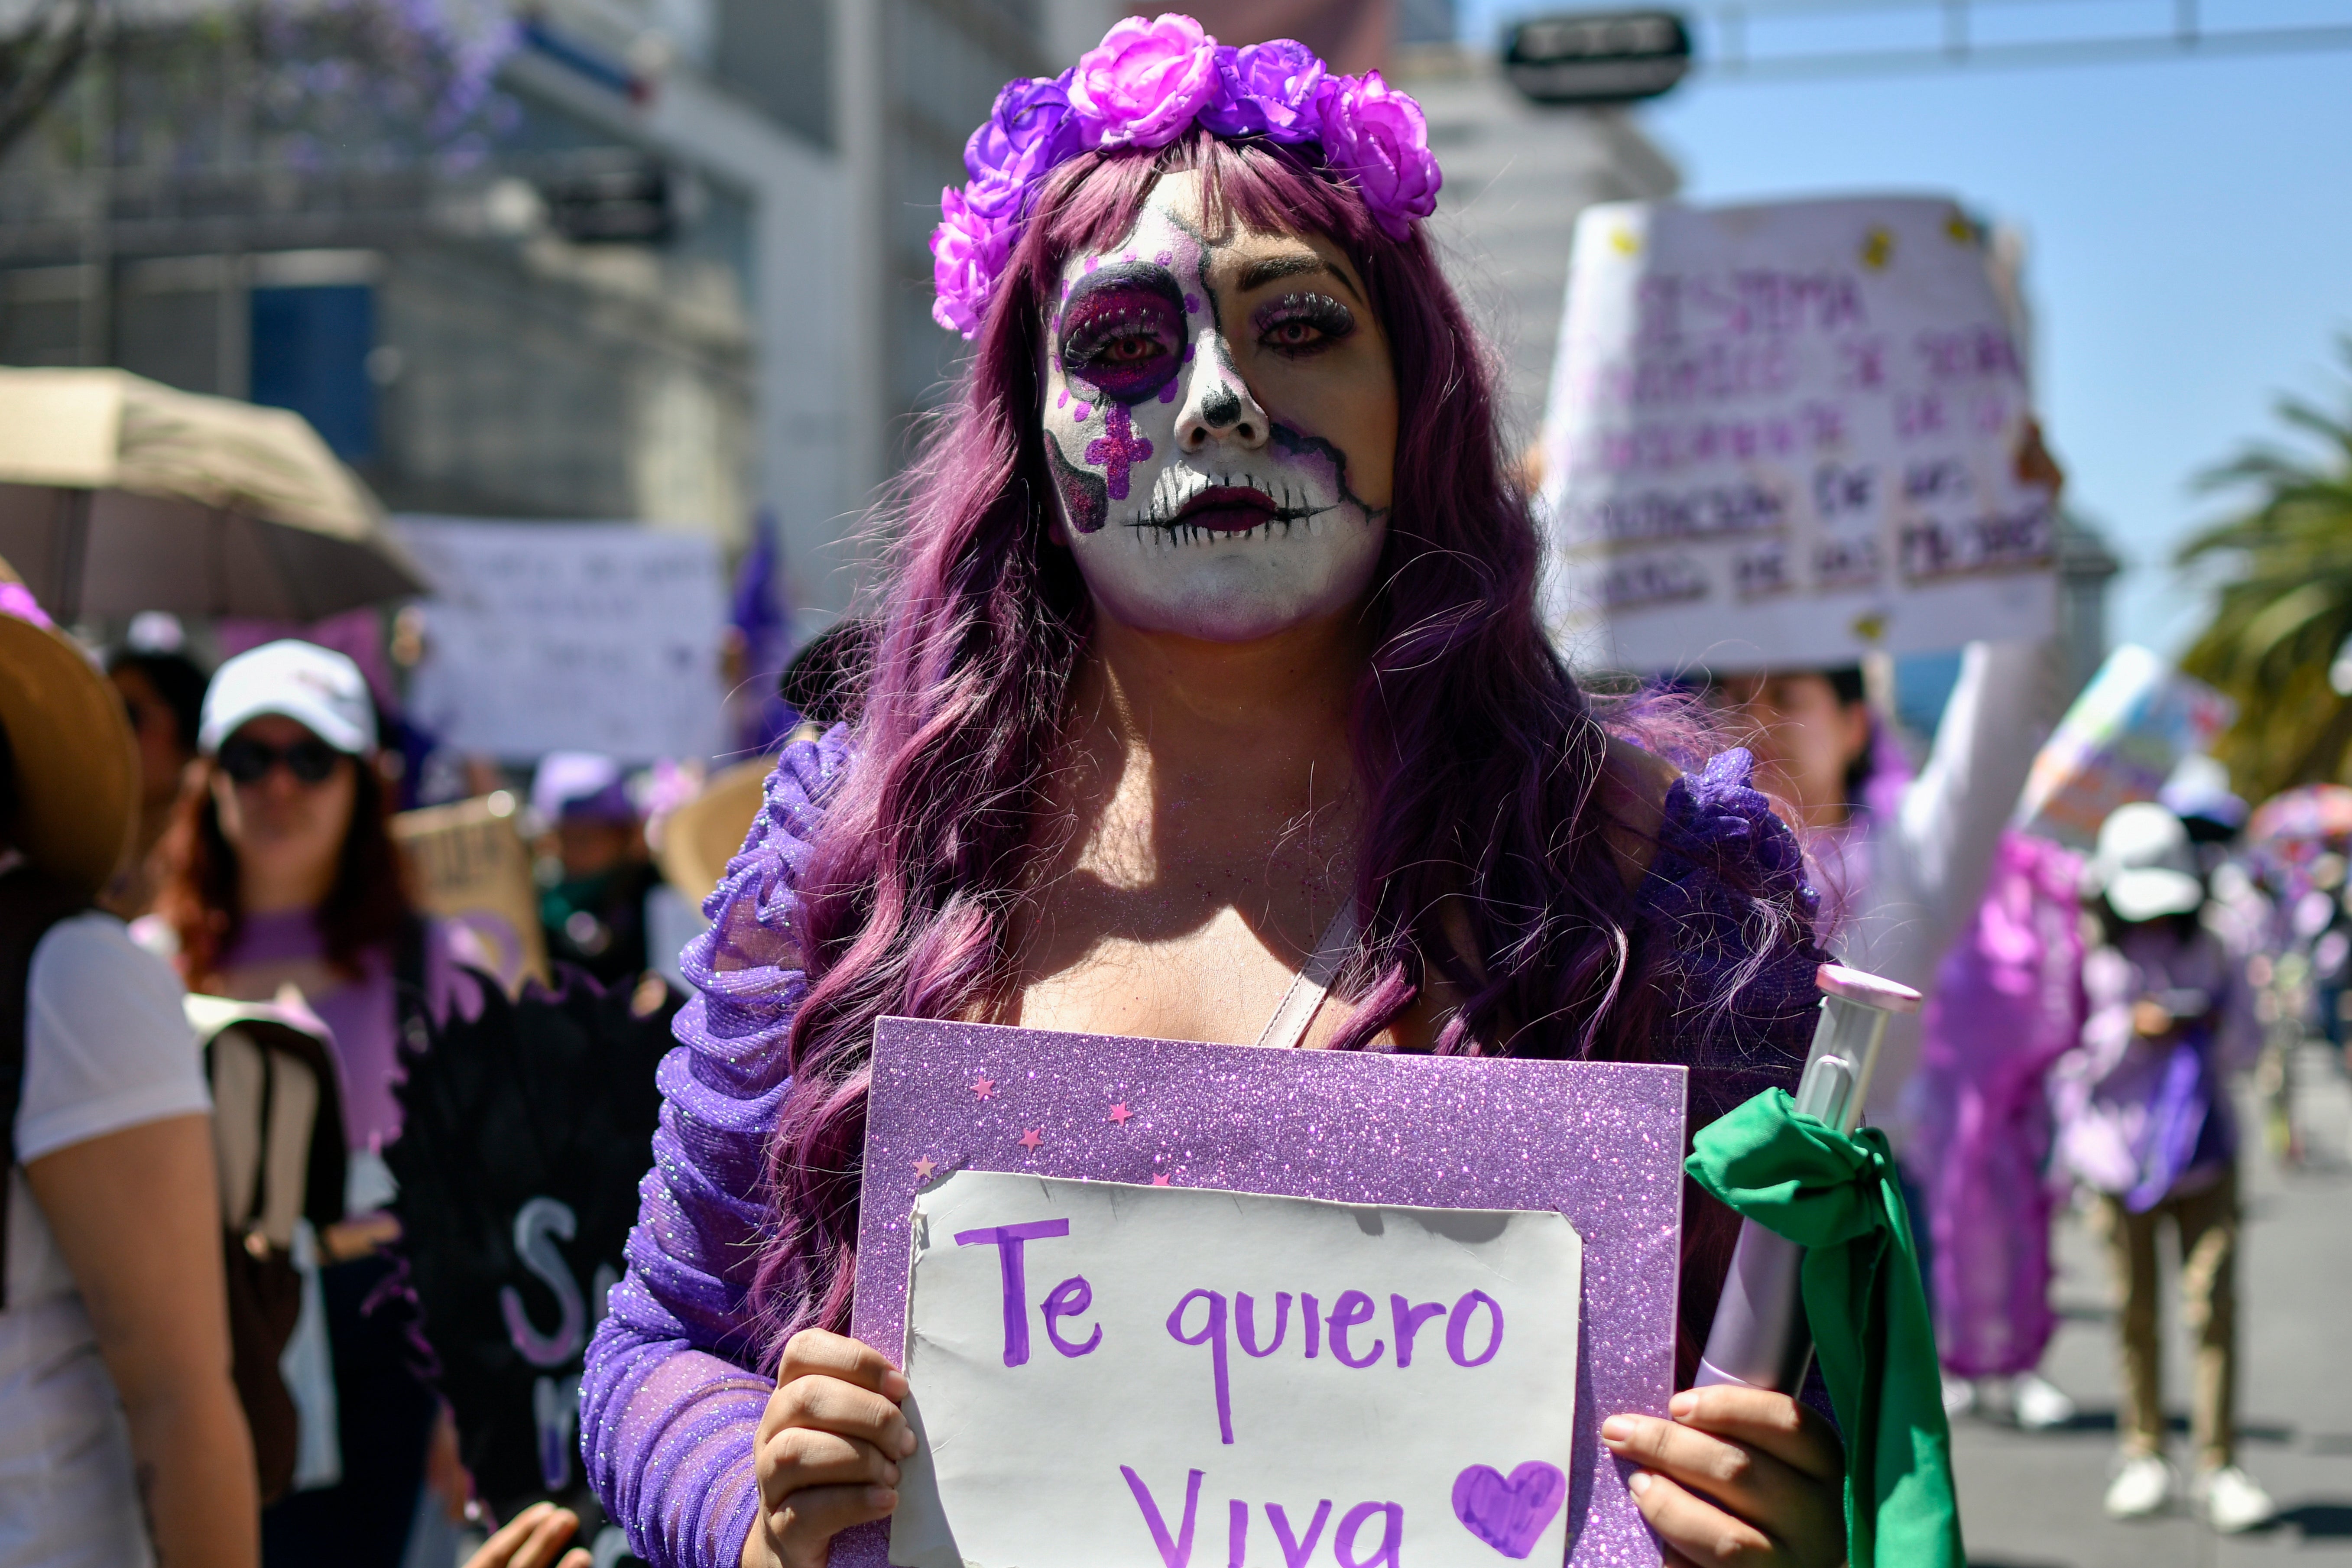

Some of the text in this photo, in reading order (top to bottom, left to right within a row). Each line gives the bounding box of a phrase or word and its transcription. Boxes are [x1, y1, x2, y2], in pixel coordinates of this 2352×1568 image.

[955, 1218, 1504, 1444] Te quiero
[1120, 1466, 1403, 1568] Viva
